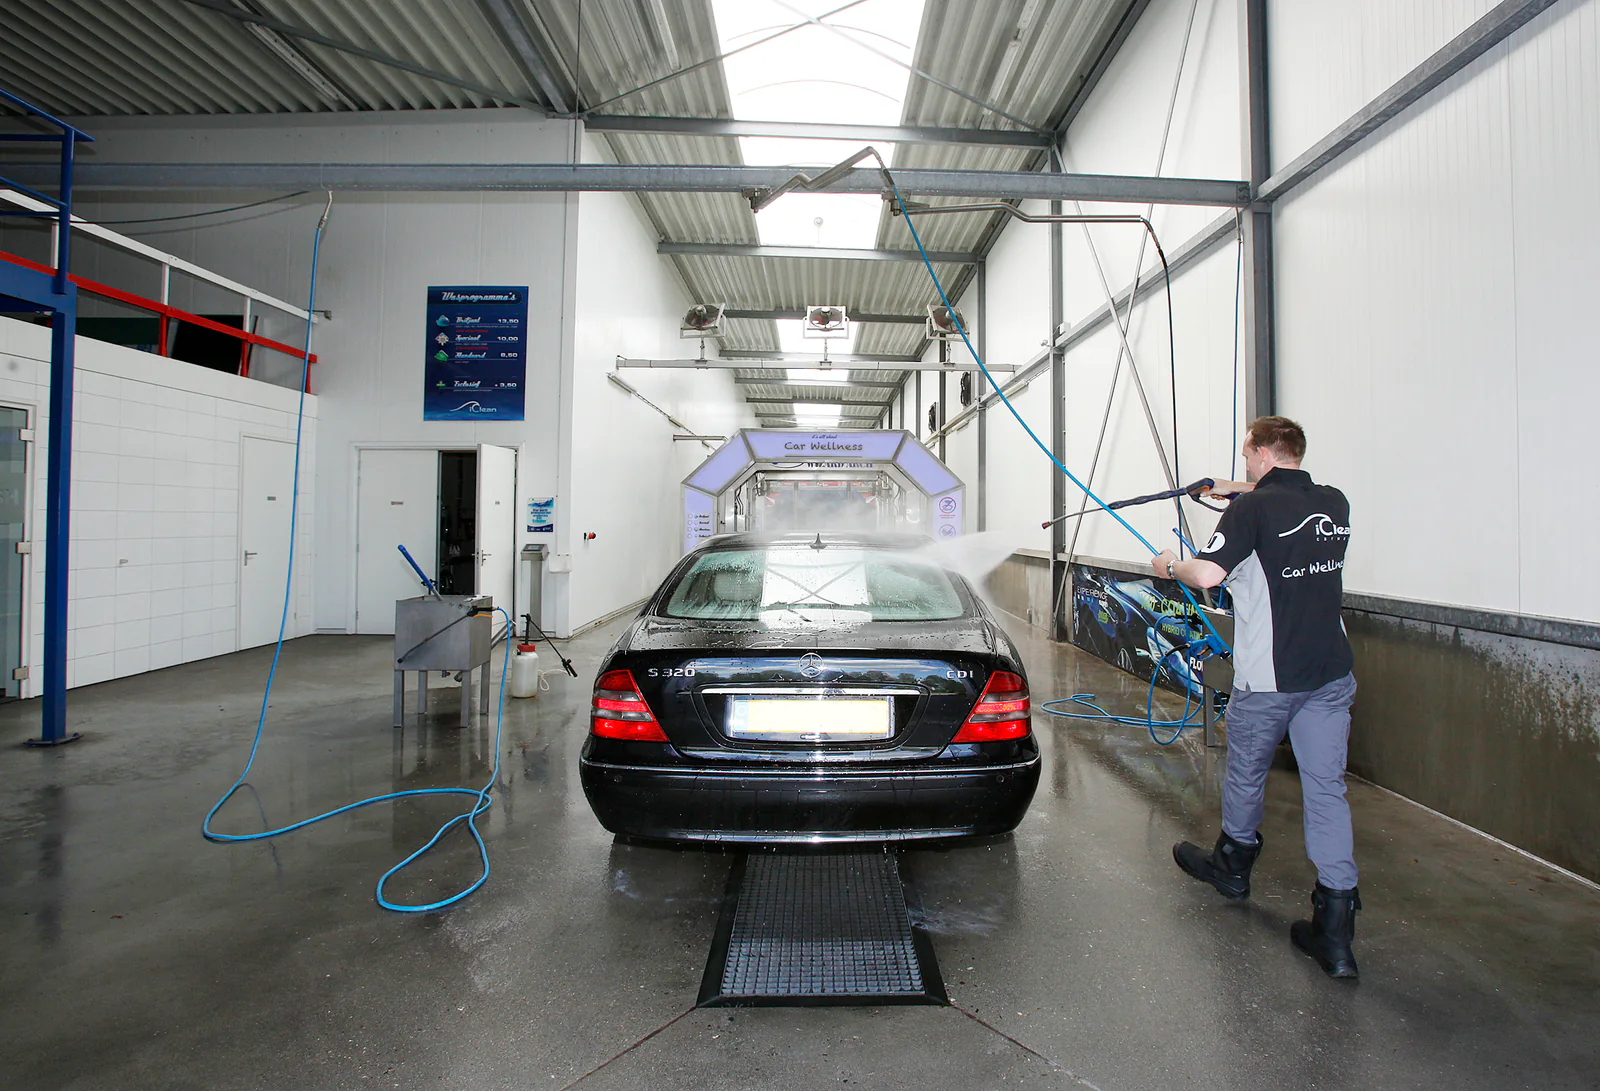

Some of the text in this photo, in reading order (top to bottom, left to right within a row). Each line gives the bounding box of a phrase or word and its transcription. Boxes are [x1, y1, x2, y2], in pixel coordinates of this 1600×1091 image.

[442, 291, 517, 302] Wasprogramma's
[469, 403, 497, 413] iClean
[784, 442, 863, 451] Car Wellness
[1315, 518, 1350, 536] iClea
[1281, 559, 1344, 579] Car Wellne
[1162, 623, 1180, 636] HYBRID
[1190, 656, 1203, 672] FLO
[648, 668, 696, 678] S 320
[946, 670, 974, 679] CDI
